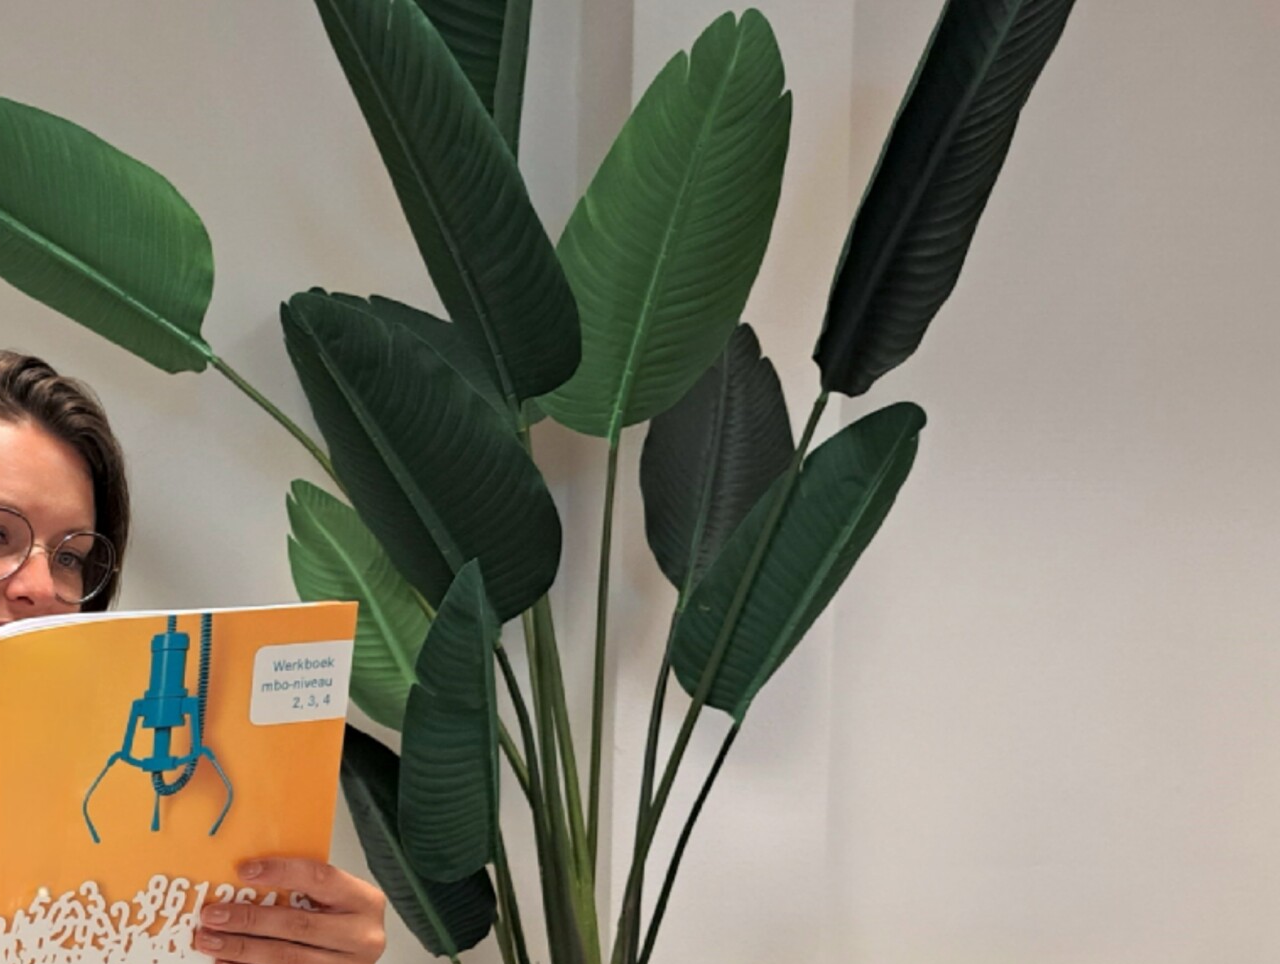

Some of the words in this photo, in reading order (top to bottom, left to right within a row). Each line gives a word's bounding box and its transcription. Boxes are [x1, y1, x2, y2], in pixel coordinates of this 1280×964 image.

[273, 657, 335, 672] Werkboek
[261, 677, 333, 693] mbo-niveau
[292, 697, 304, 710] 2,
[307, 696, 318, 708] 3,
[323, 694, 331, 705] 4
